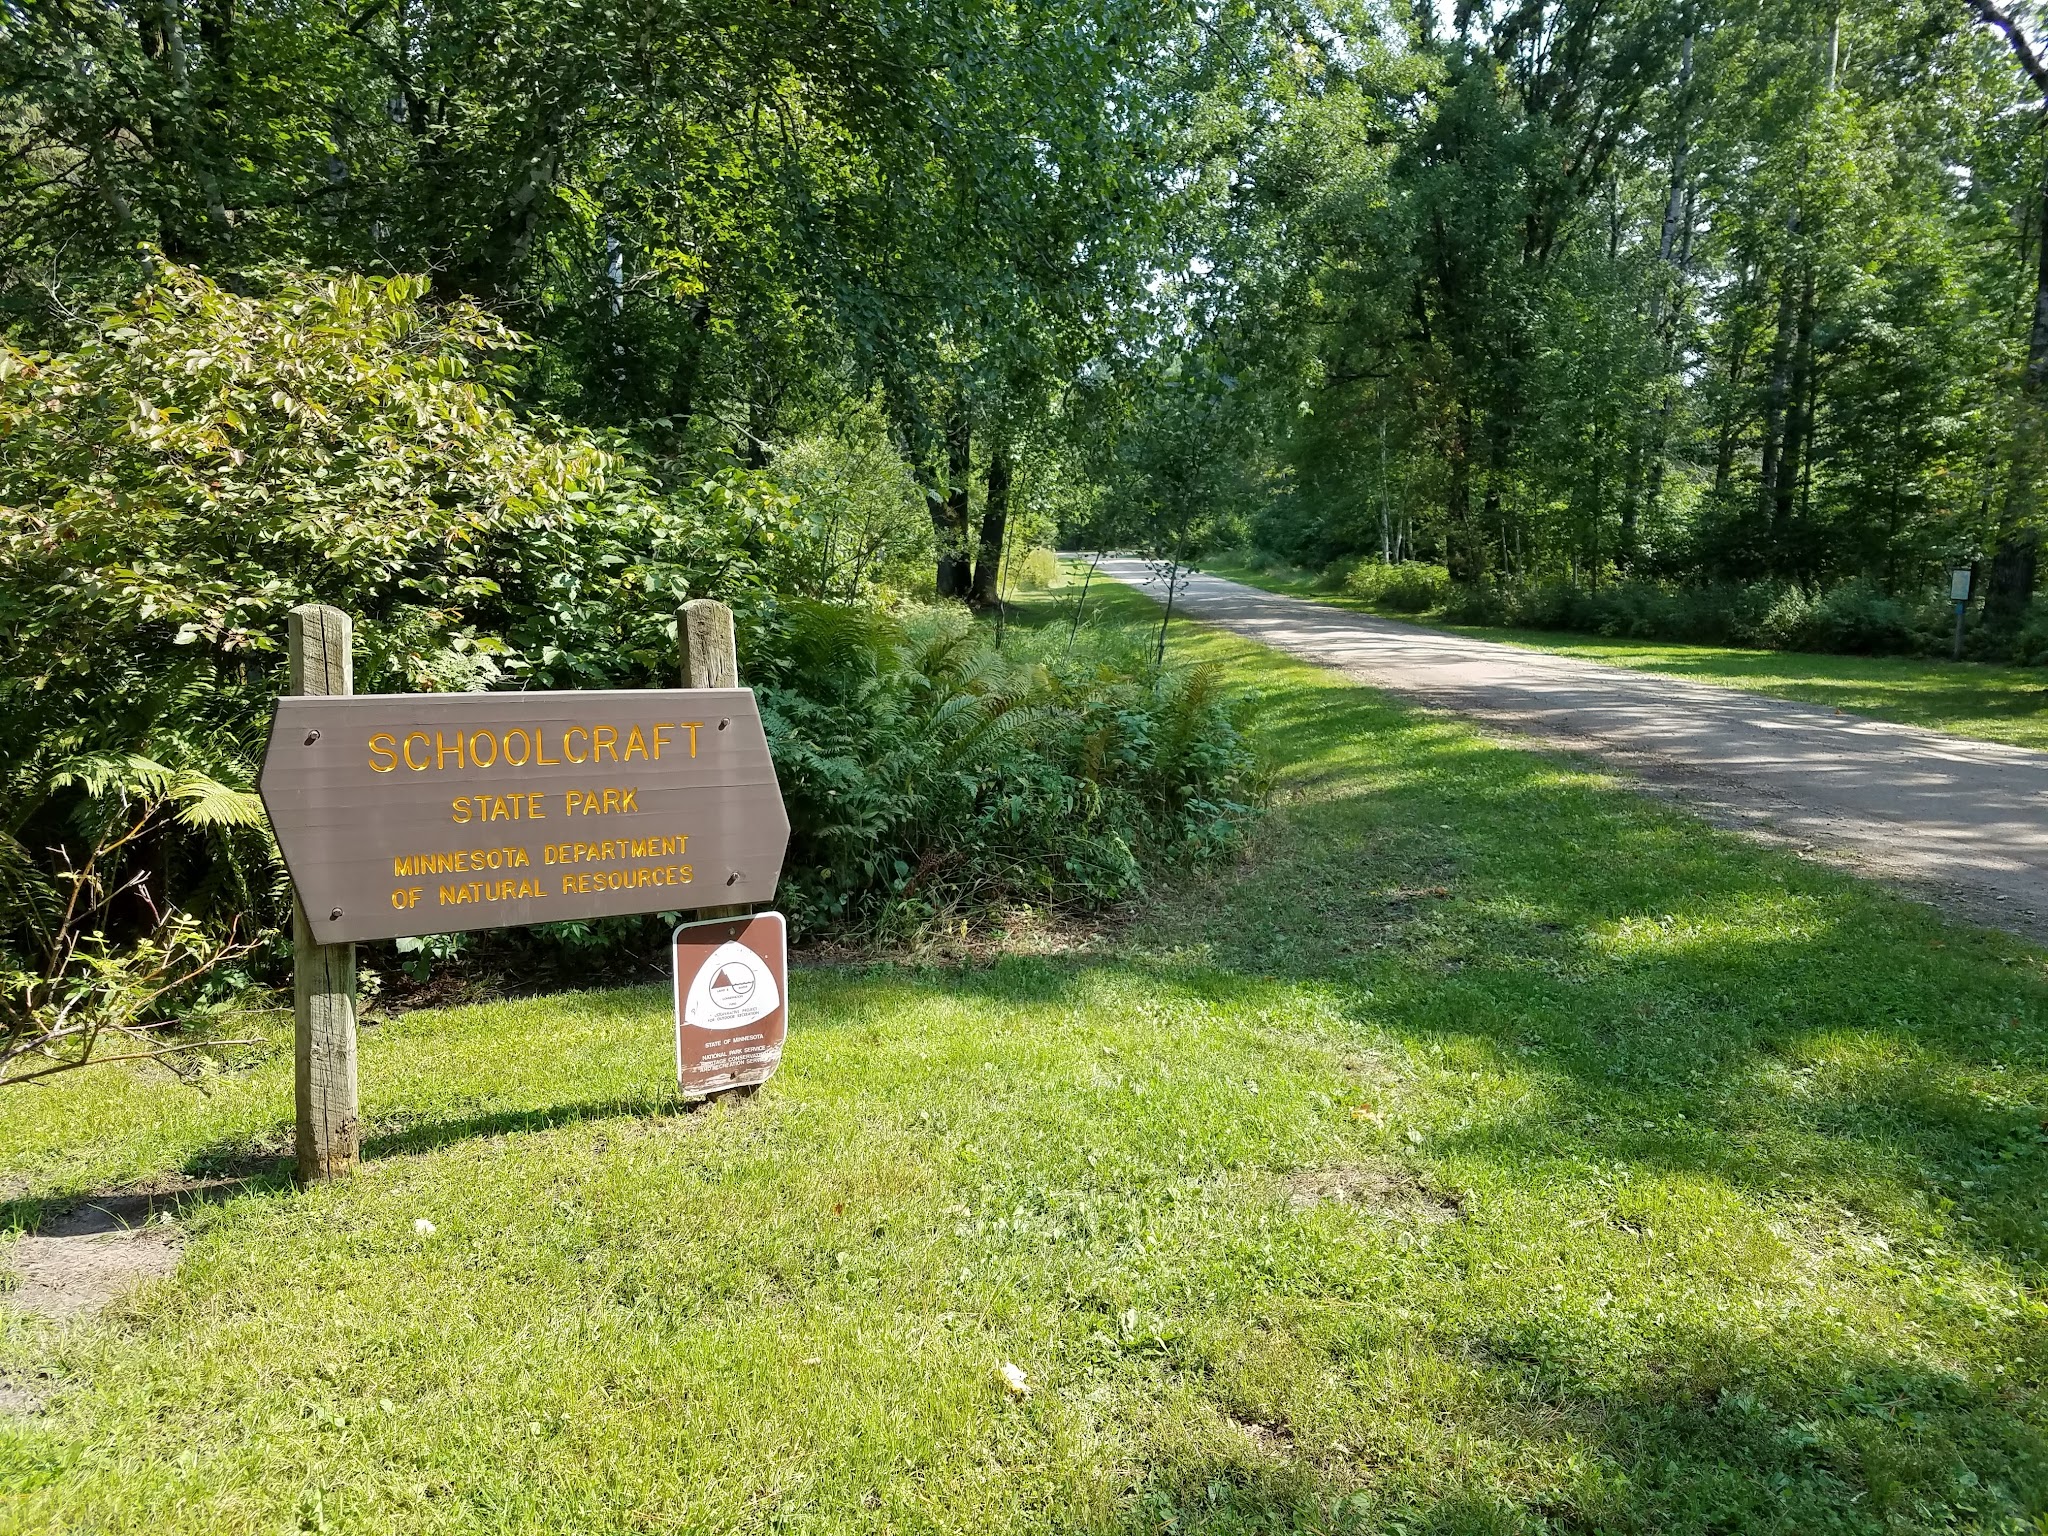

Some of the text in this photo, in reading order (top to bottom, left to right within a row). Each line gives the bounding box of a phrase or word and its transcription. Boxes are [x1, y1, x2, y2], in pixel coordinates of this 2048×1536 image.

[368, 722, 704, 772] SCHOOLCRAFT
[452, 787, 638, 824] STATE PARK
[394, 835, 689, 877] MINNESOTA DEPARTMENT
[391, 864, 693, 911] OF NATURAL RESOURCES
[702, 1052, 727, 1060] NATIONAL
[744, 1045, 765, 1053] SERVICE
[705, 1040, 722, 1048] STATE
[732, 1033, 764, 1043] MINNESOTA
